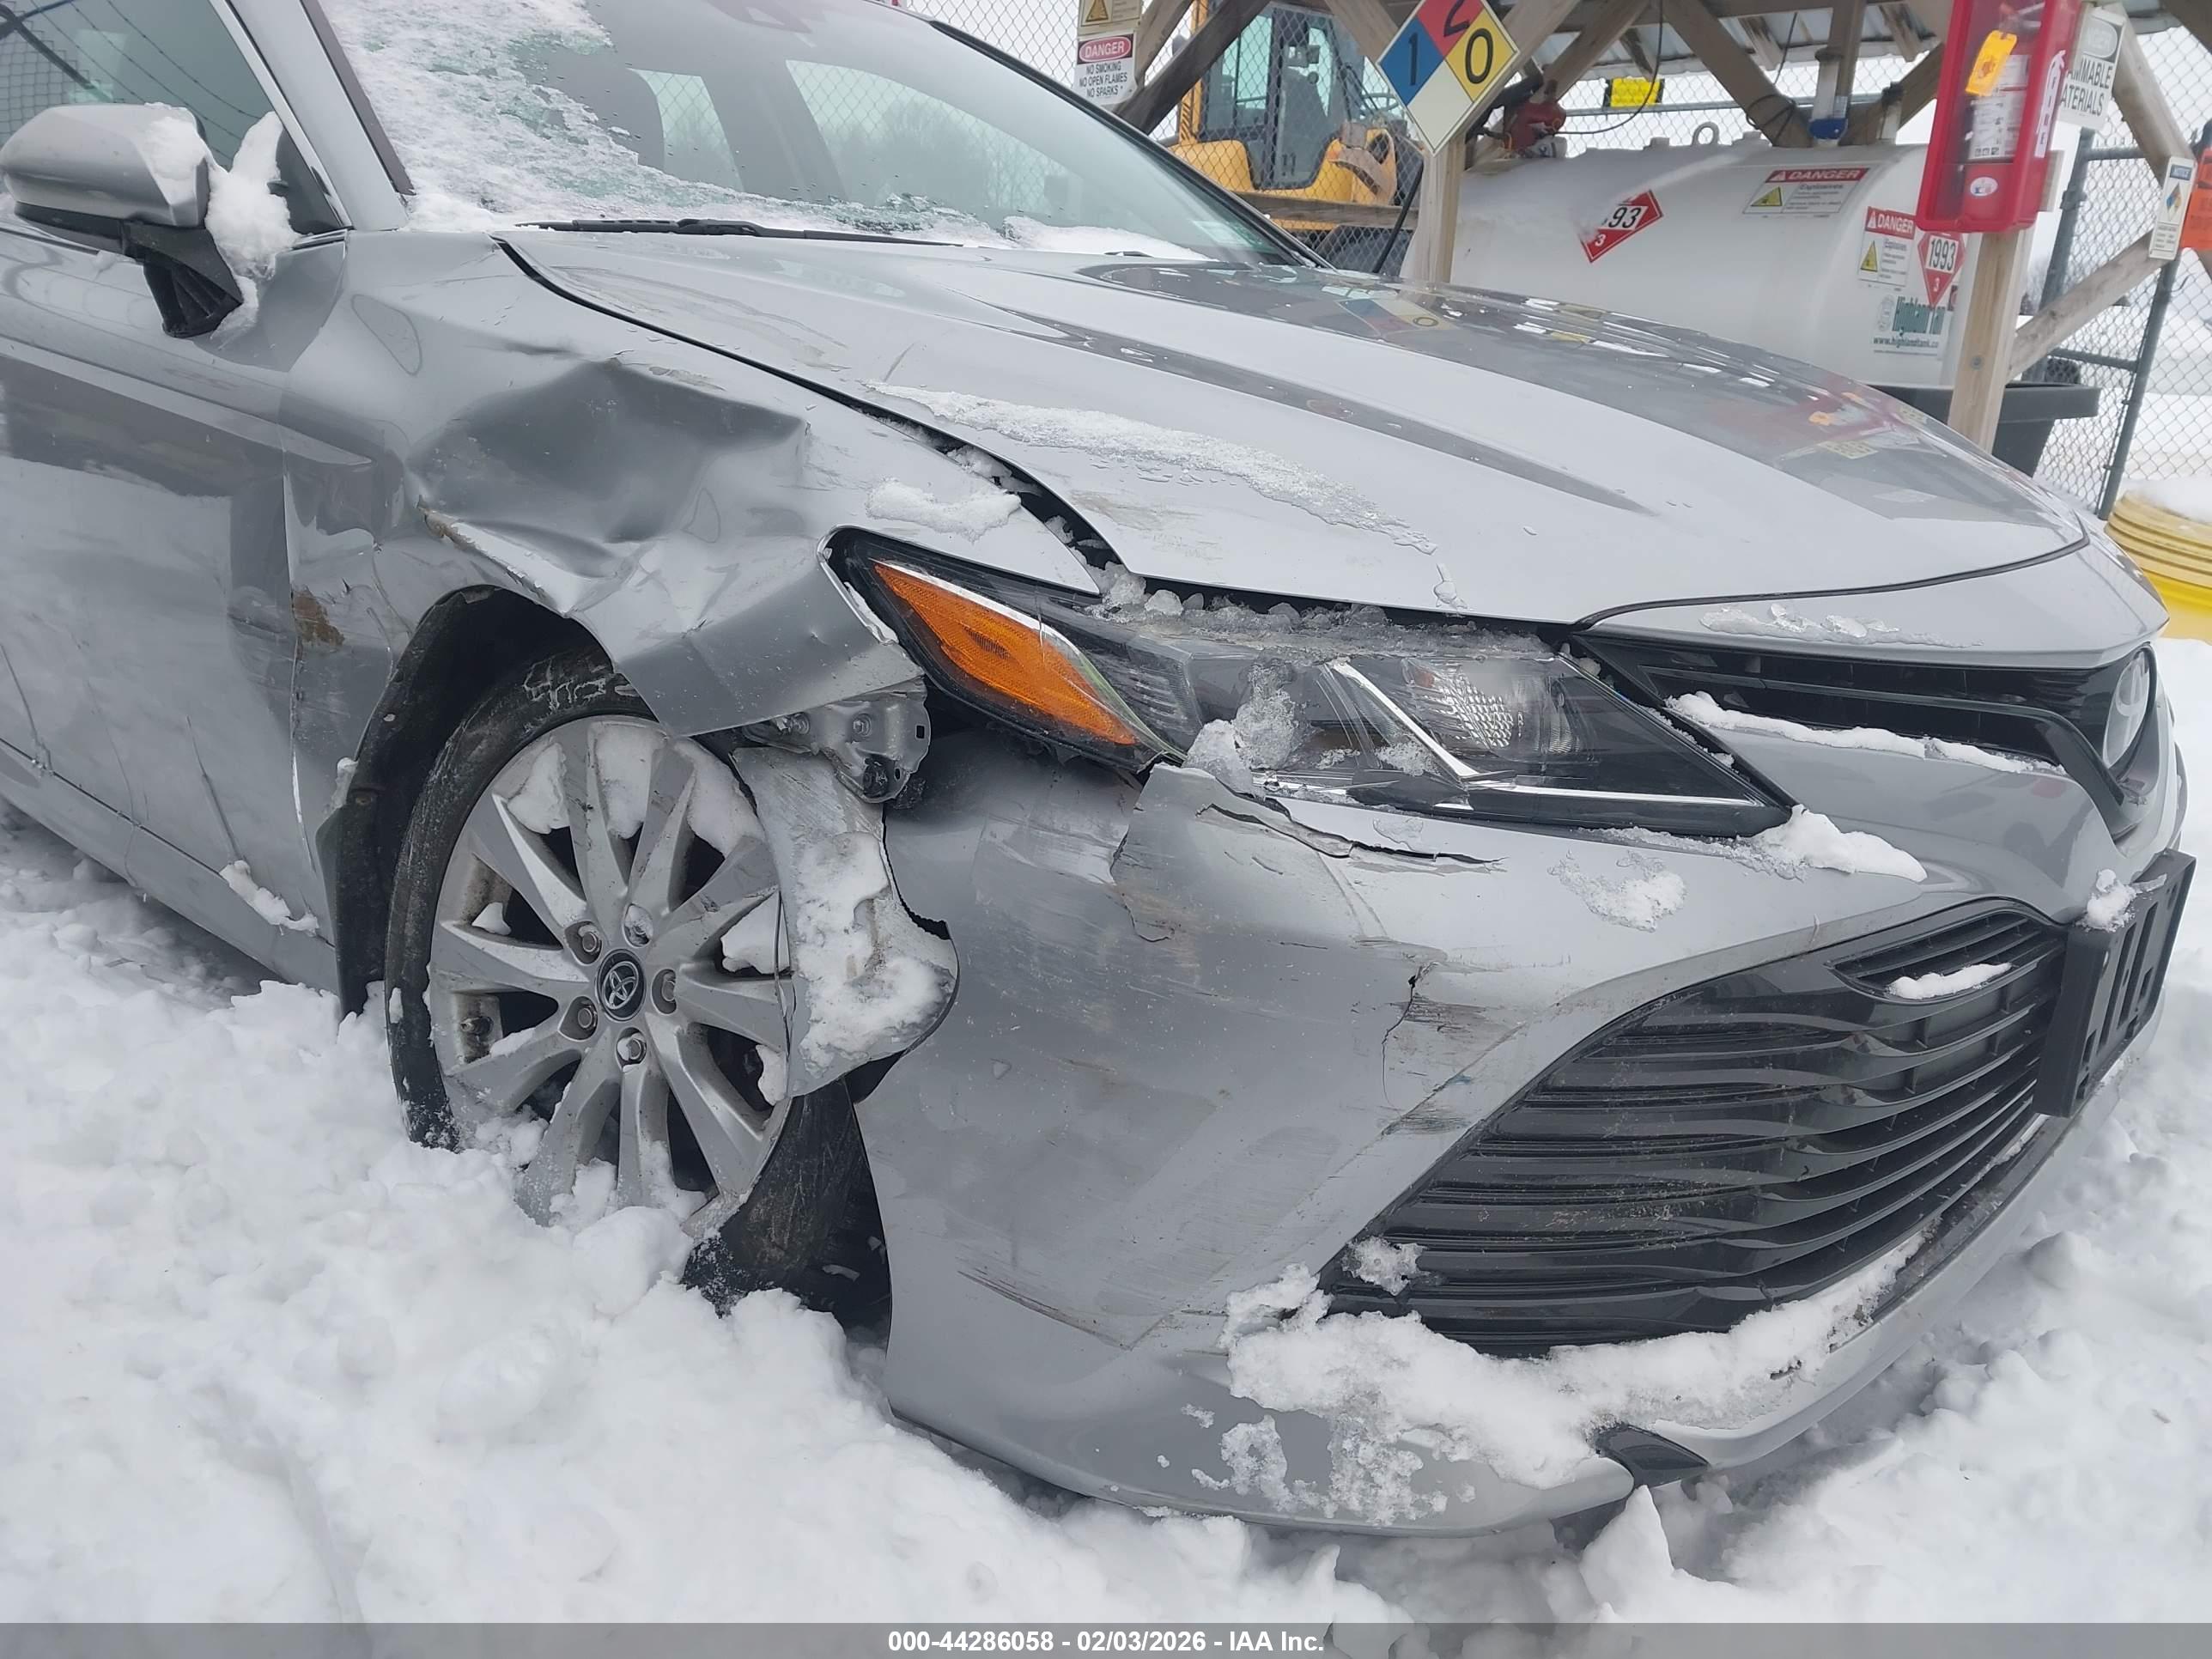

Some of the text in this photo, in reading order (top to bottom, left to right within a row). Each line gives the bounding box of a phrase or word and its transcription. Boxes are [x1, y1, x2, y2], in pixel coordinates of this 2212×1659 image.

[1085, 40, 1125, 58] DANGER
[1465, 28, 1494, 84] 0
[1408, 32, 1419, 85] 1
[1086, 61, 1121, 75] NO SMOKING
[1079, 72, 1127, 88] NO OPEN FLAMES
[1086, 86, 1119, 97] NO SPARKS
[2061, 84, 2104, 116] ATERIALS
[1789, 170, 1861, 179] DANGER
[1607, 207, 1642, 228] 93
[1878, 213, 1914, 234] DANGER
[1595, 234, 1607, 246] 3
[1929, 239, 1957, 270] 1993
[1933, 277, 1941, 292] 3
